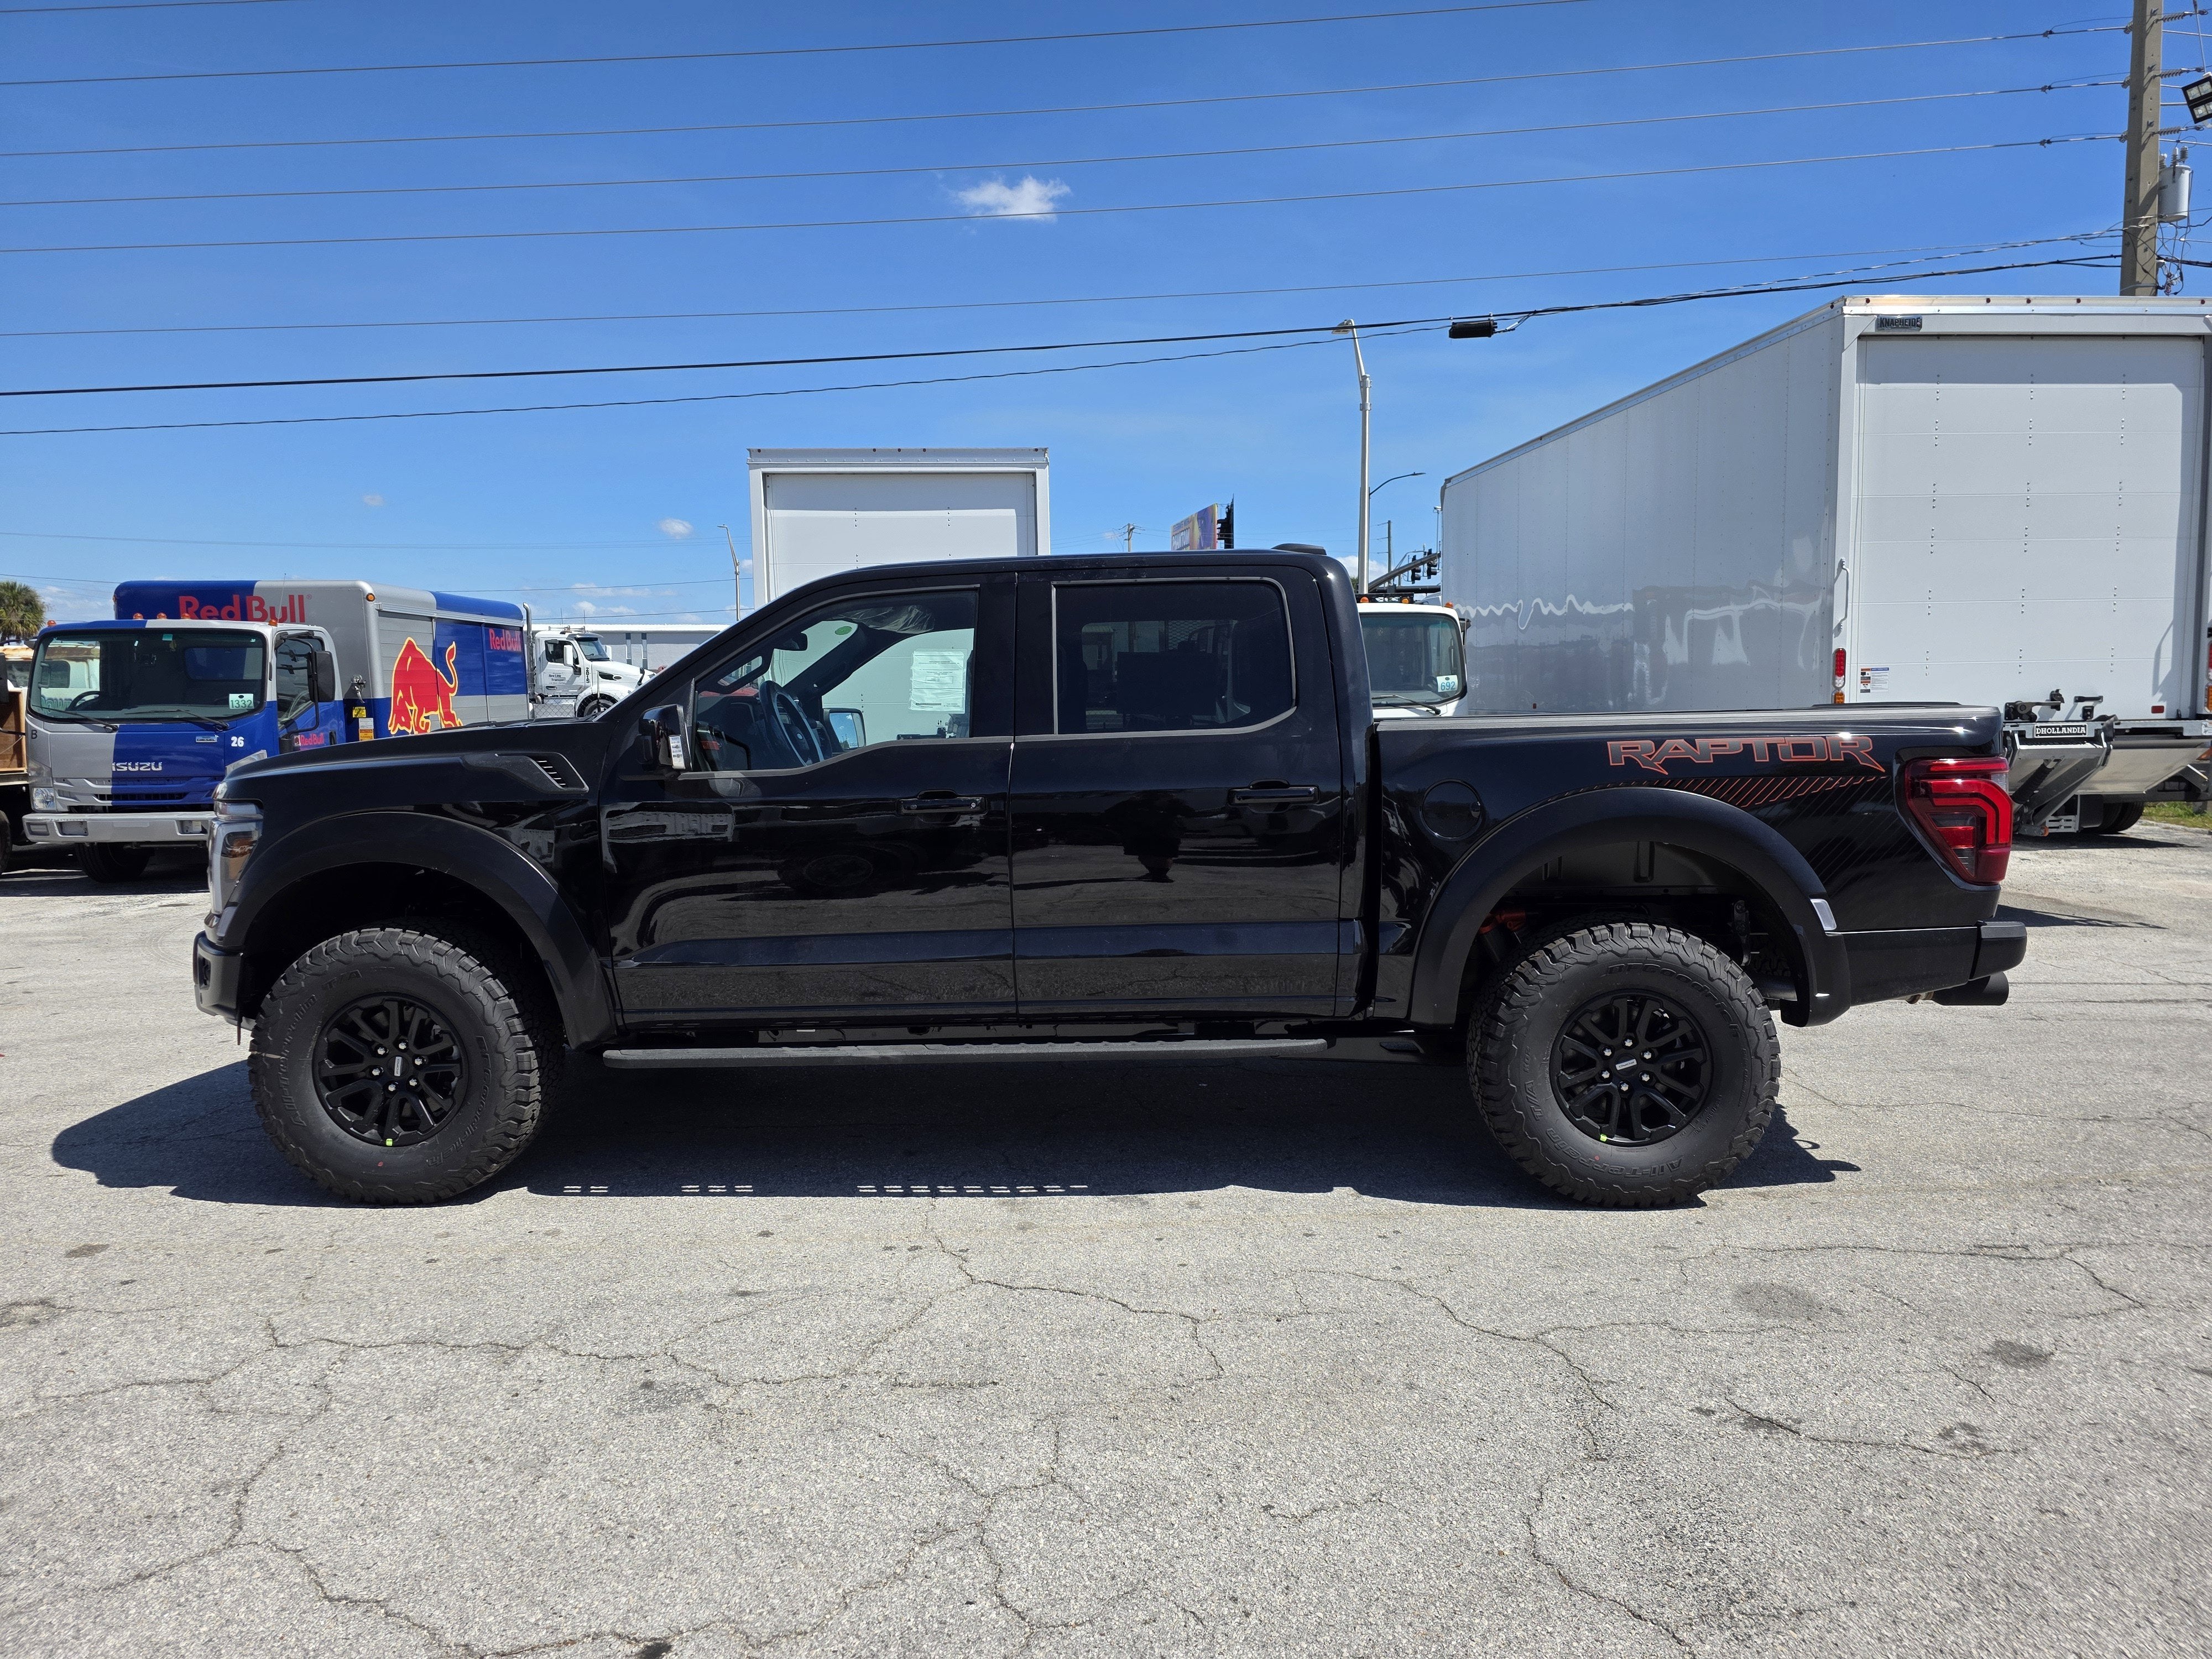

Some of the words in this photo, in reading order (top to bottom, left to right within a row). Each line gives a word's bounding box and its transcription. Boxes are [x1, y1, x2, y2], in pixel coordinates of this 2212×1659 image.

[1880, 317, 1922, 328] KNAPHEIDE
[179, 594, 242, 621] Red
[246, 594, 306, 623] Bull
[489, 628, 506, 650] Red
[505, 629, 521, 651] Bull
[1441, 681, 1455, 691] 692
[230, 700, 253, 708] 1332
[31, 729, 38, 739] B
[2036, 727, 2086, 735] DHOLLANDIA
[231, 736, 244, 747] 26
[300, 734, 312, 745] Red
[312, 733, 324, 744] Bull
[1607, 736, 1886, 775] RAPTOR
[112, 761, 163, 771] ISUZU
[1525, 1080, 1544, 1121] T/A
[1546, 1128, 1683, 1177] All-Terrain
